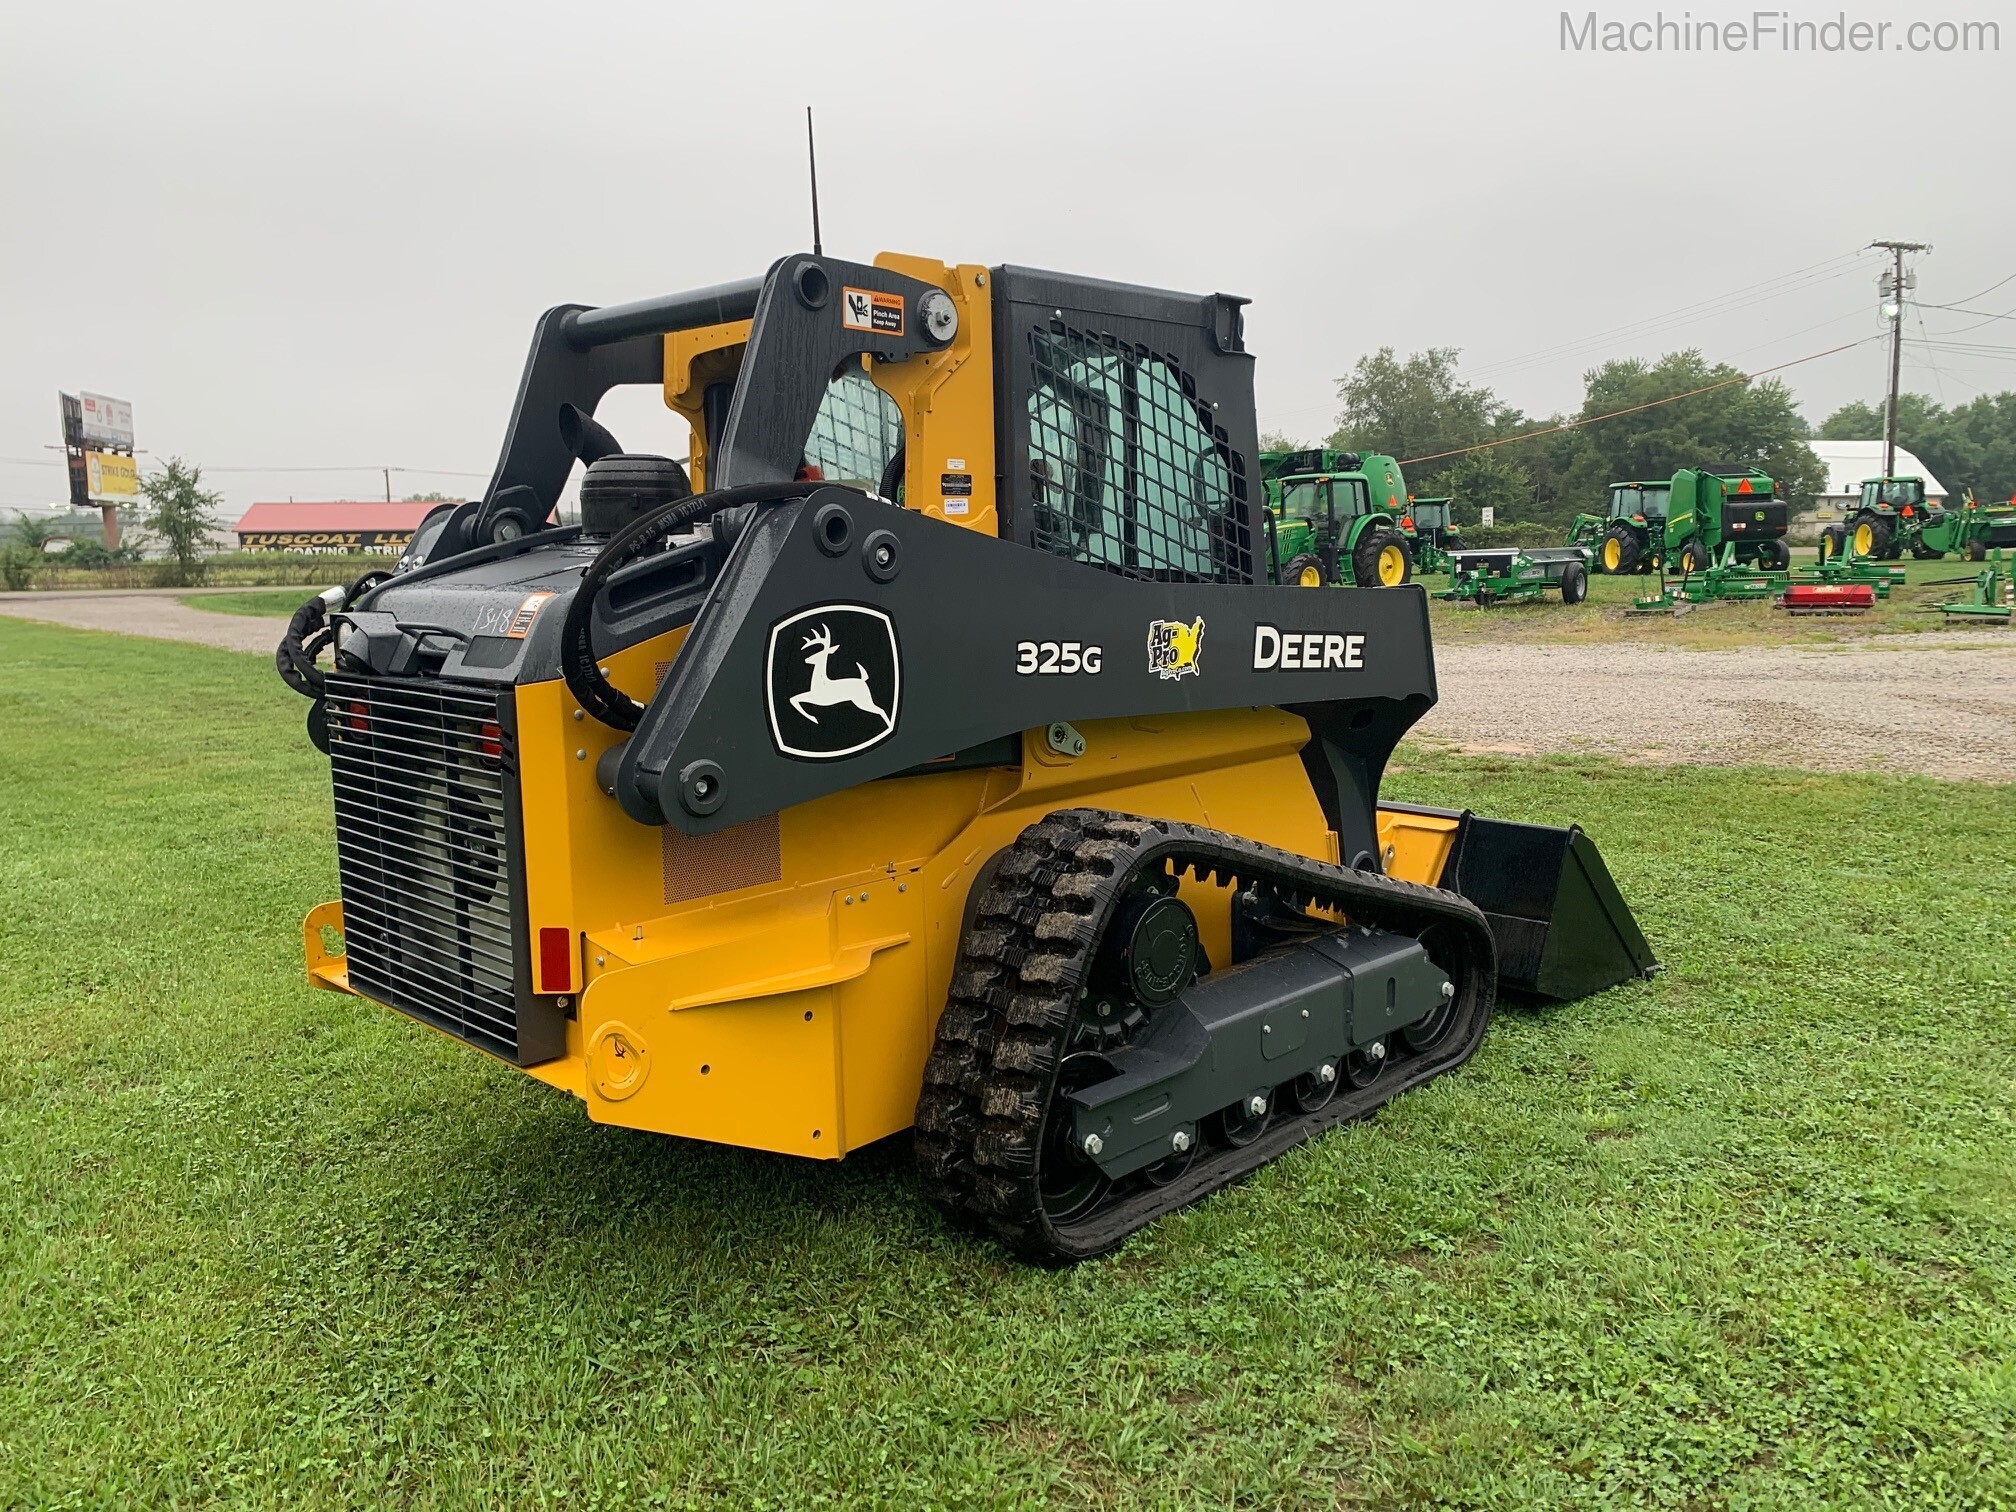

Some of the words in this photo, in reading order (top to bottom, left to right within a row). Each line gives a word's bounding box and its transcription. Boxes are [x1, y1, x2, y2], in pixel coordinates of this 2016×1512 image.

[880, 297, 901, 306] WARNING
[873, 310, 887, 318] Pinch
[889, 312, 900, 320] Area
[885, 320, 897, 328] Away
[243, 534, 362, 544] TUSCOAT
[284, 546, 349, 556] COATING
[472, 605, 515, 635] 1348
[1253, 626, 1366, 669] DEERE
[1016, 641, 1102, 675] 325G
[1151, 645, 1178, 668] Pro
